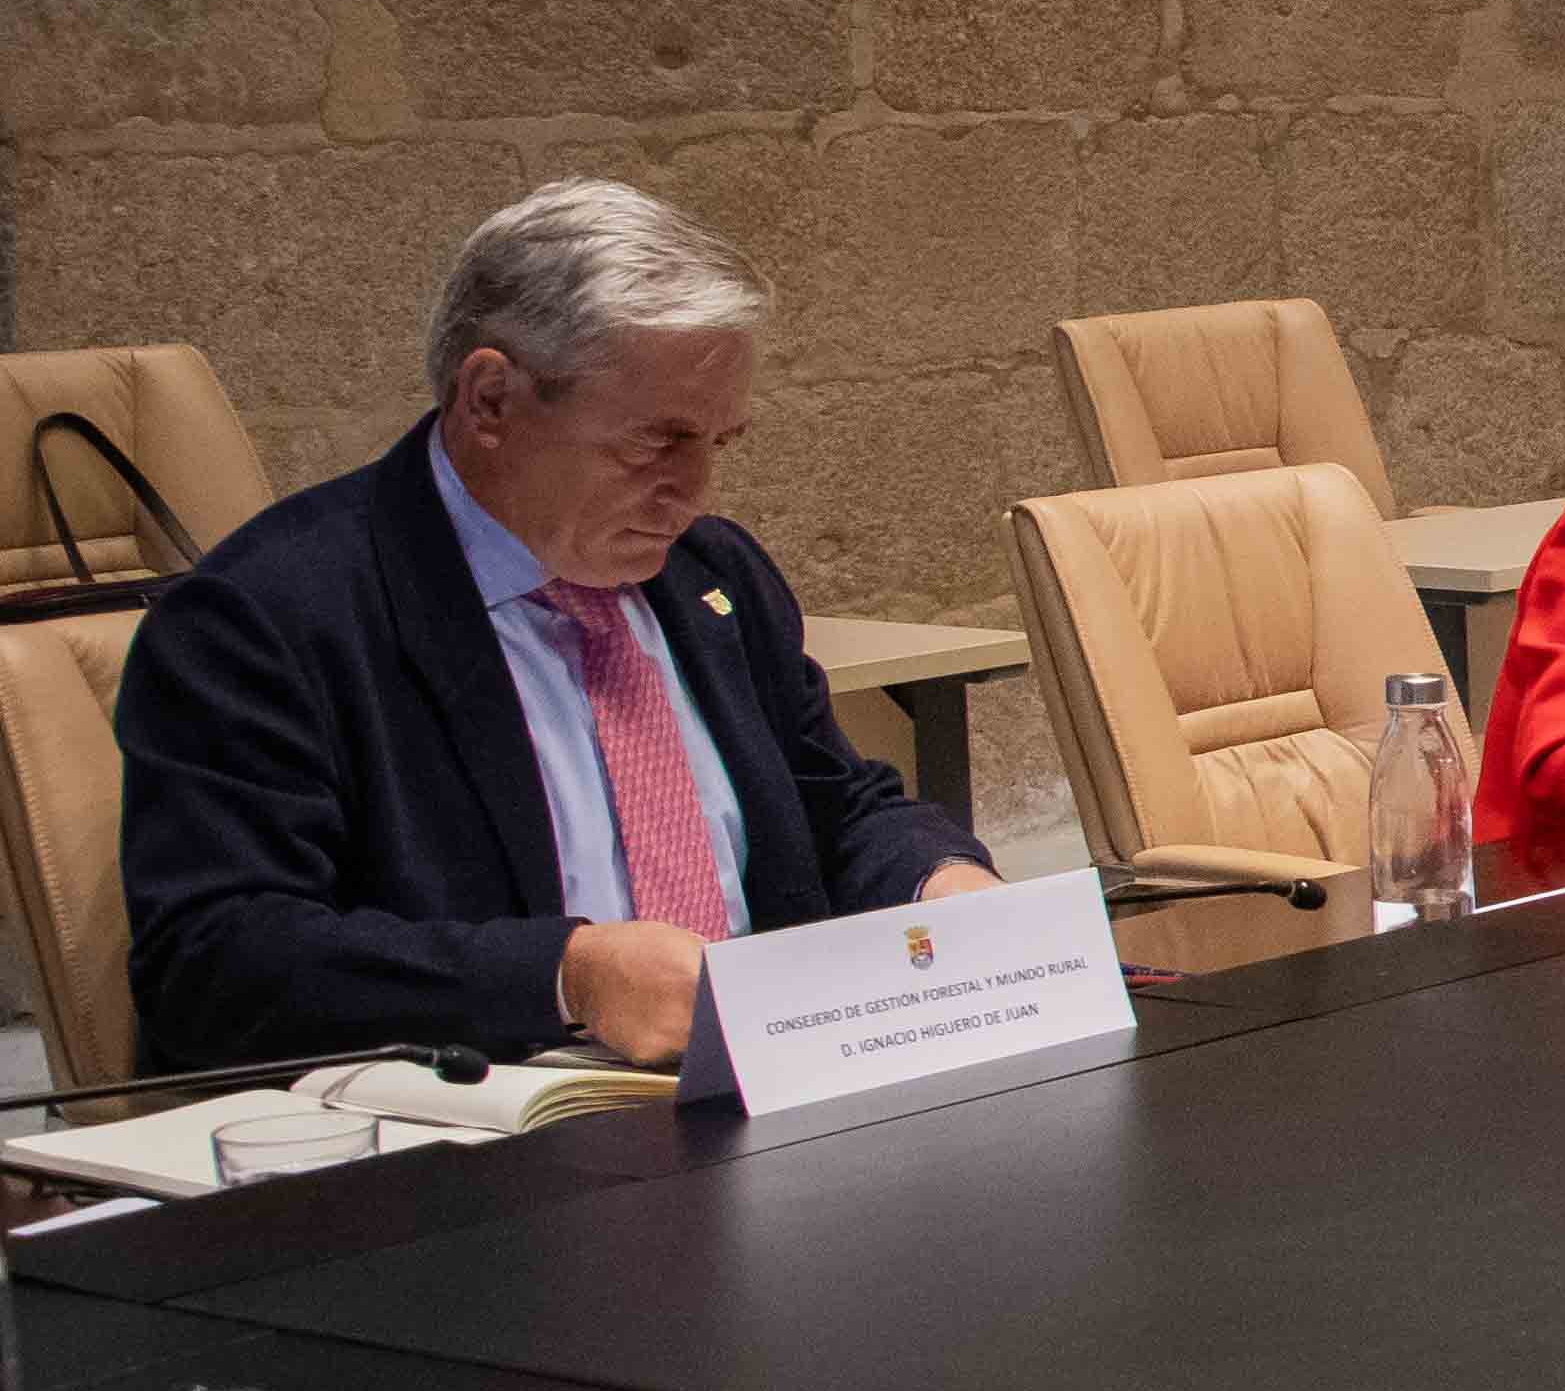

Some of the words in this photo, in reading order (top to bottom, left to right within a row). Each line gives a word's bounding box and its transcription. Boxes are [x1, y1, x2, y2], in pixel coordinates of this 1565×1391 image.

[766, 1010, 843, 1036] CONSEJERO
[846, 1004, 863, 1019] DE
[866, 990, 921, 1014] GESTIÓN
[923, 979, 984, 1003] FORESTAL
[986, 977, 994, 989] Y
[997, 966, 1046, 986] MUNDO
[1048, 956, 1088, 976] RURAL
[841, 1043, 857, 1058] D.
[859, 1029, 918, 1054] IGNACIO
[920, 1015, 982, 1038] HIGUERO
[984, 1011, 1002, 1025] DE
[1005, 1003, 1040, 1022] JUAN
